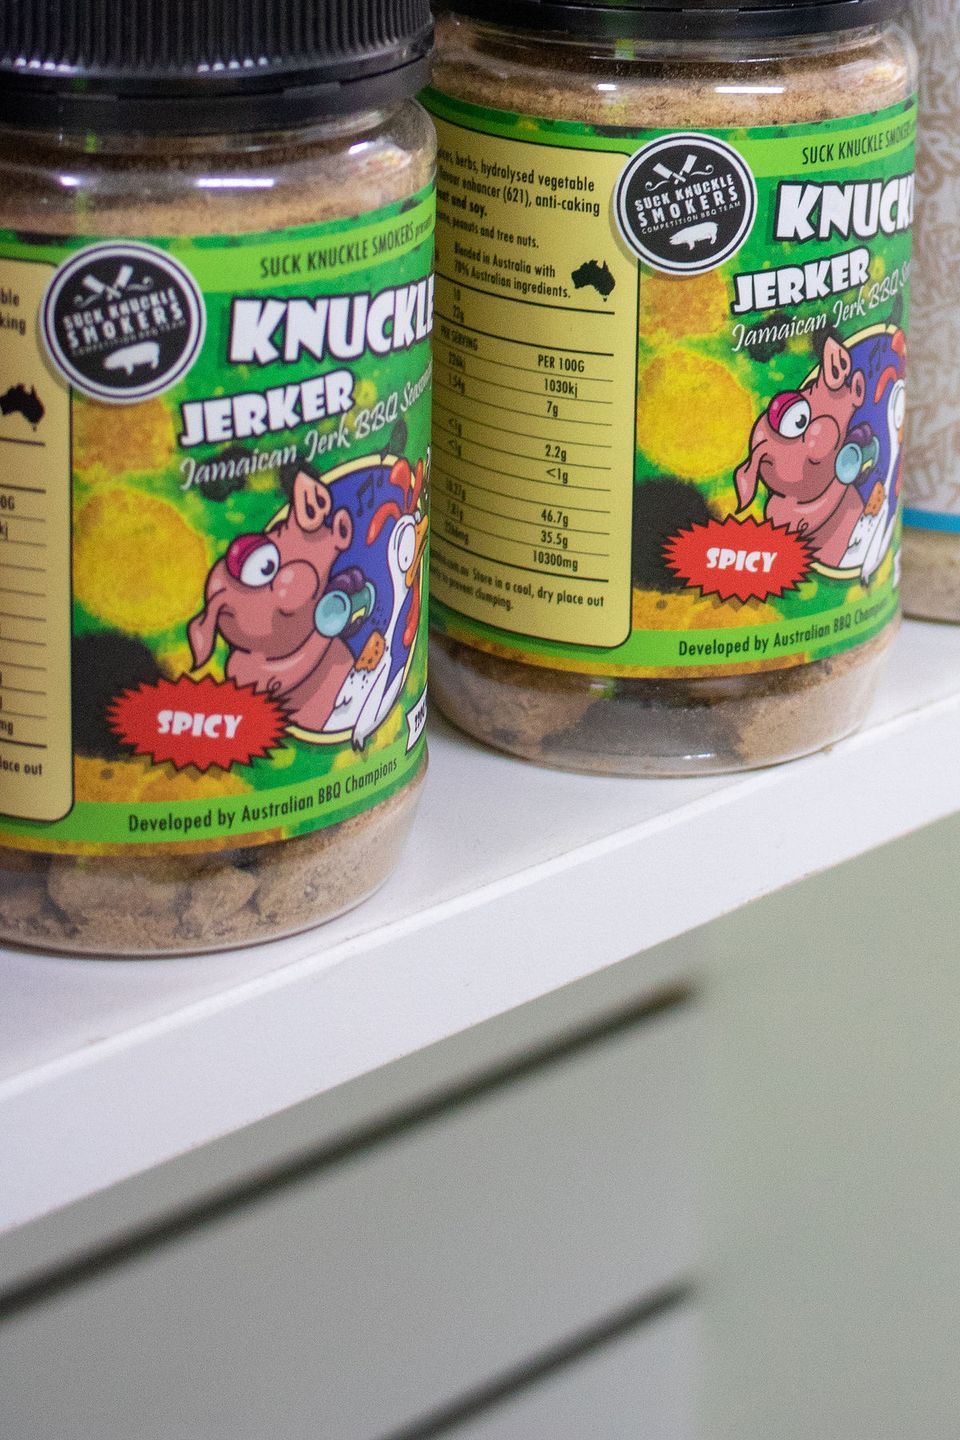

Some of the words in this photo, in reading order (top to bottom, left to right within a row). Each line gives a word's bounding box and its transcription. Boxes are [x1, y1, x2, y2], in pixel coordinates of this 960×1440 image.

[802, 142, 834, 165] SUCK
[838, 133, 883, 160] KNUCKLE
[481, 158, 535, 187] hydrolysed
[538, 172, 595, 192] vegetable
[462, 177, 500, 198] enhancer
[503, 184, 532, 208] (621),
[535, 194, 601, 217] anti-caking
[634, 193, 671, 212] SUCK
[675, 174, 734, 201] KNUCKLE
[637, 185, 739, 228] SMOKERS
[641, 214, 698, 235] COMPETITION
[719, 201, 741, 213] TEAM
[260, 252, 301, 279] SUCK
[307, 244, 370, 271] KNUCKLE
[372, 221, 414, 256] SMOKERS
[480, 226, 495, 239] and
[497, 228, 514, 244] tree
[516, 235, 540, 249] nuts.
[470, 265, 512, 289] Australian
[513, 276, 571, 299] ingredients.
[492, 253, 532, 274] Australia
[534, 262, 556, 278] with
[731, 245, 871, 315] JERKER
[63, 307, 104, 331] SUCK
[108, 287, 178, 319] KNUCKLE
[67, 302, 183, 349] SMOKERS
[731, 314, 827, 353] Jamaican
[833, 286, 867, 329] Jerk
[868, 269, 899, 309] BBQ
[537, 354, 555, 369] PER
[559, 357, 585, 373] 100G
[544, 378, 578, 399] 1030kj
[179, 369, 356, 448] JERKER
[547, 401, 559, 418] 7g
[180, 447, 297, 491] Jamaican
[304, 418, 350, 468] Jerk
[353, 391, 398, 441] BBQ
[545, 444, 567, 462] 2.2g
[546, 467, 568, 484] <1g
[541, 509, 568, 528] 46.7g
[541, 530, 568, 549] 35.5g
[533, 550, 578, 572] 10300mg
[706, 547, 778, 573] SPICY
[513, 584, 534, 599] cool,
[537, 586, 553, 602] dry
[556, 590, 583, 607] place
[587, 596, 604, 607] out
[678, 637, 750, 657] Developed
[754, 635, 769, 654] by
[773, 624, 830, 648] Australian
[833, 613, 852, 634] BBQ
[157, 709, 245, 739] SPICY
[24, 762, 43, 776] out
[128, 807, 212, 834] Developed
[217, 808, 236, 830] by
[241, 794, 314, 823] Australian
[318, 781, 342, 806] BBQ
[345, 758, 398, 795] Champions
